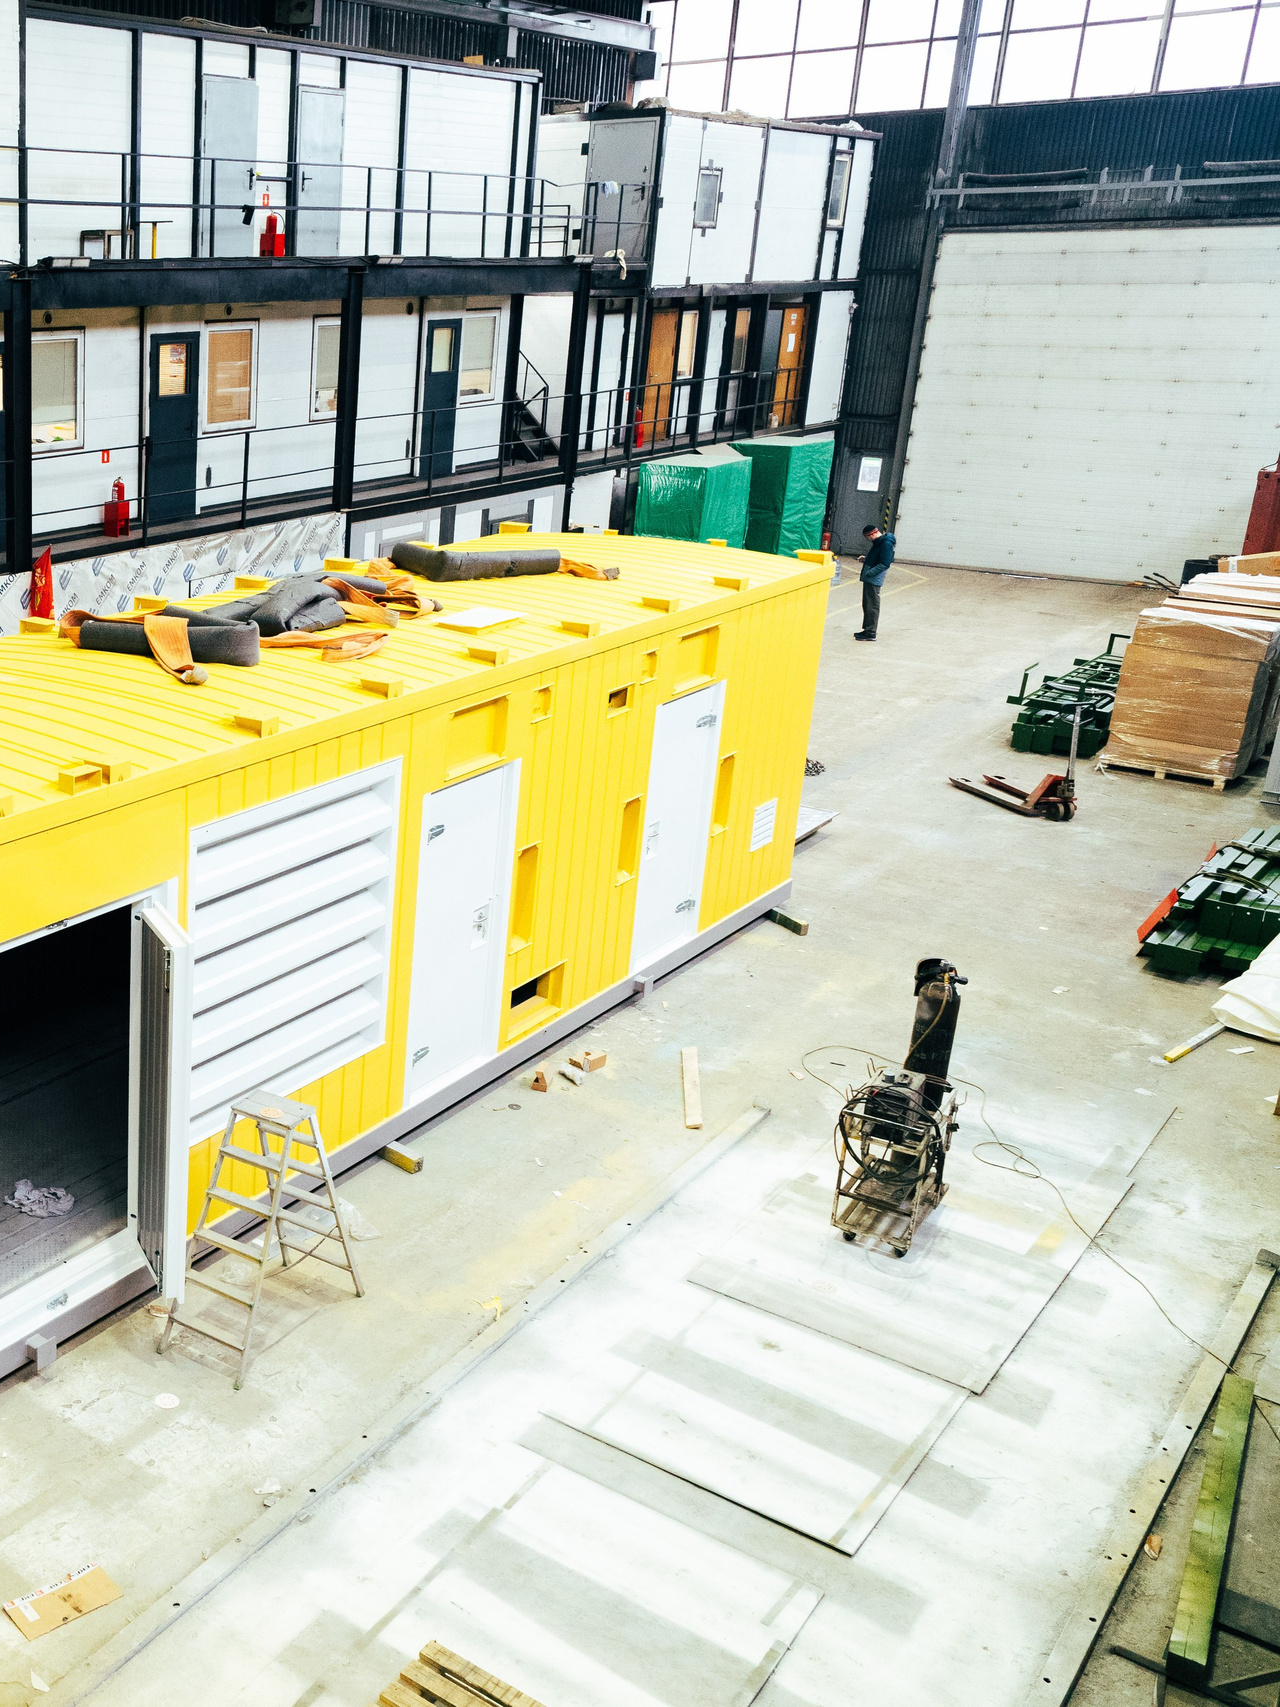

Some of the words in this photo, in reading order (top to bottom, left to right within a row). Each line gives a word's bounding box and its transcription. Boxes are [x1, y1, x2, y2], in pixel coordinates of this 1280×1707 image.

[301, 524, 318, 552] EMKOM
[326, 517, 341, 541] EMKO
[162, 544, 182, 574] EMKOM
[193, 537, 208, 561] EMKO
[272, 540, 289, 568] EMKOM
[126, 561, 147, 592] EMKOM
[246, 551, 263, 576] MKOM
[95, 574, 116, 606] EMKOM
[191, 580, 204, 598] KOM
